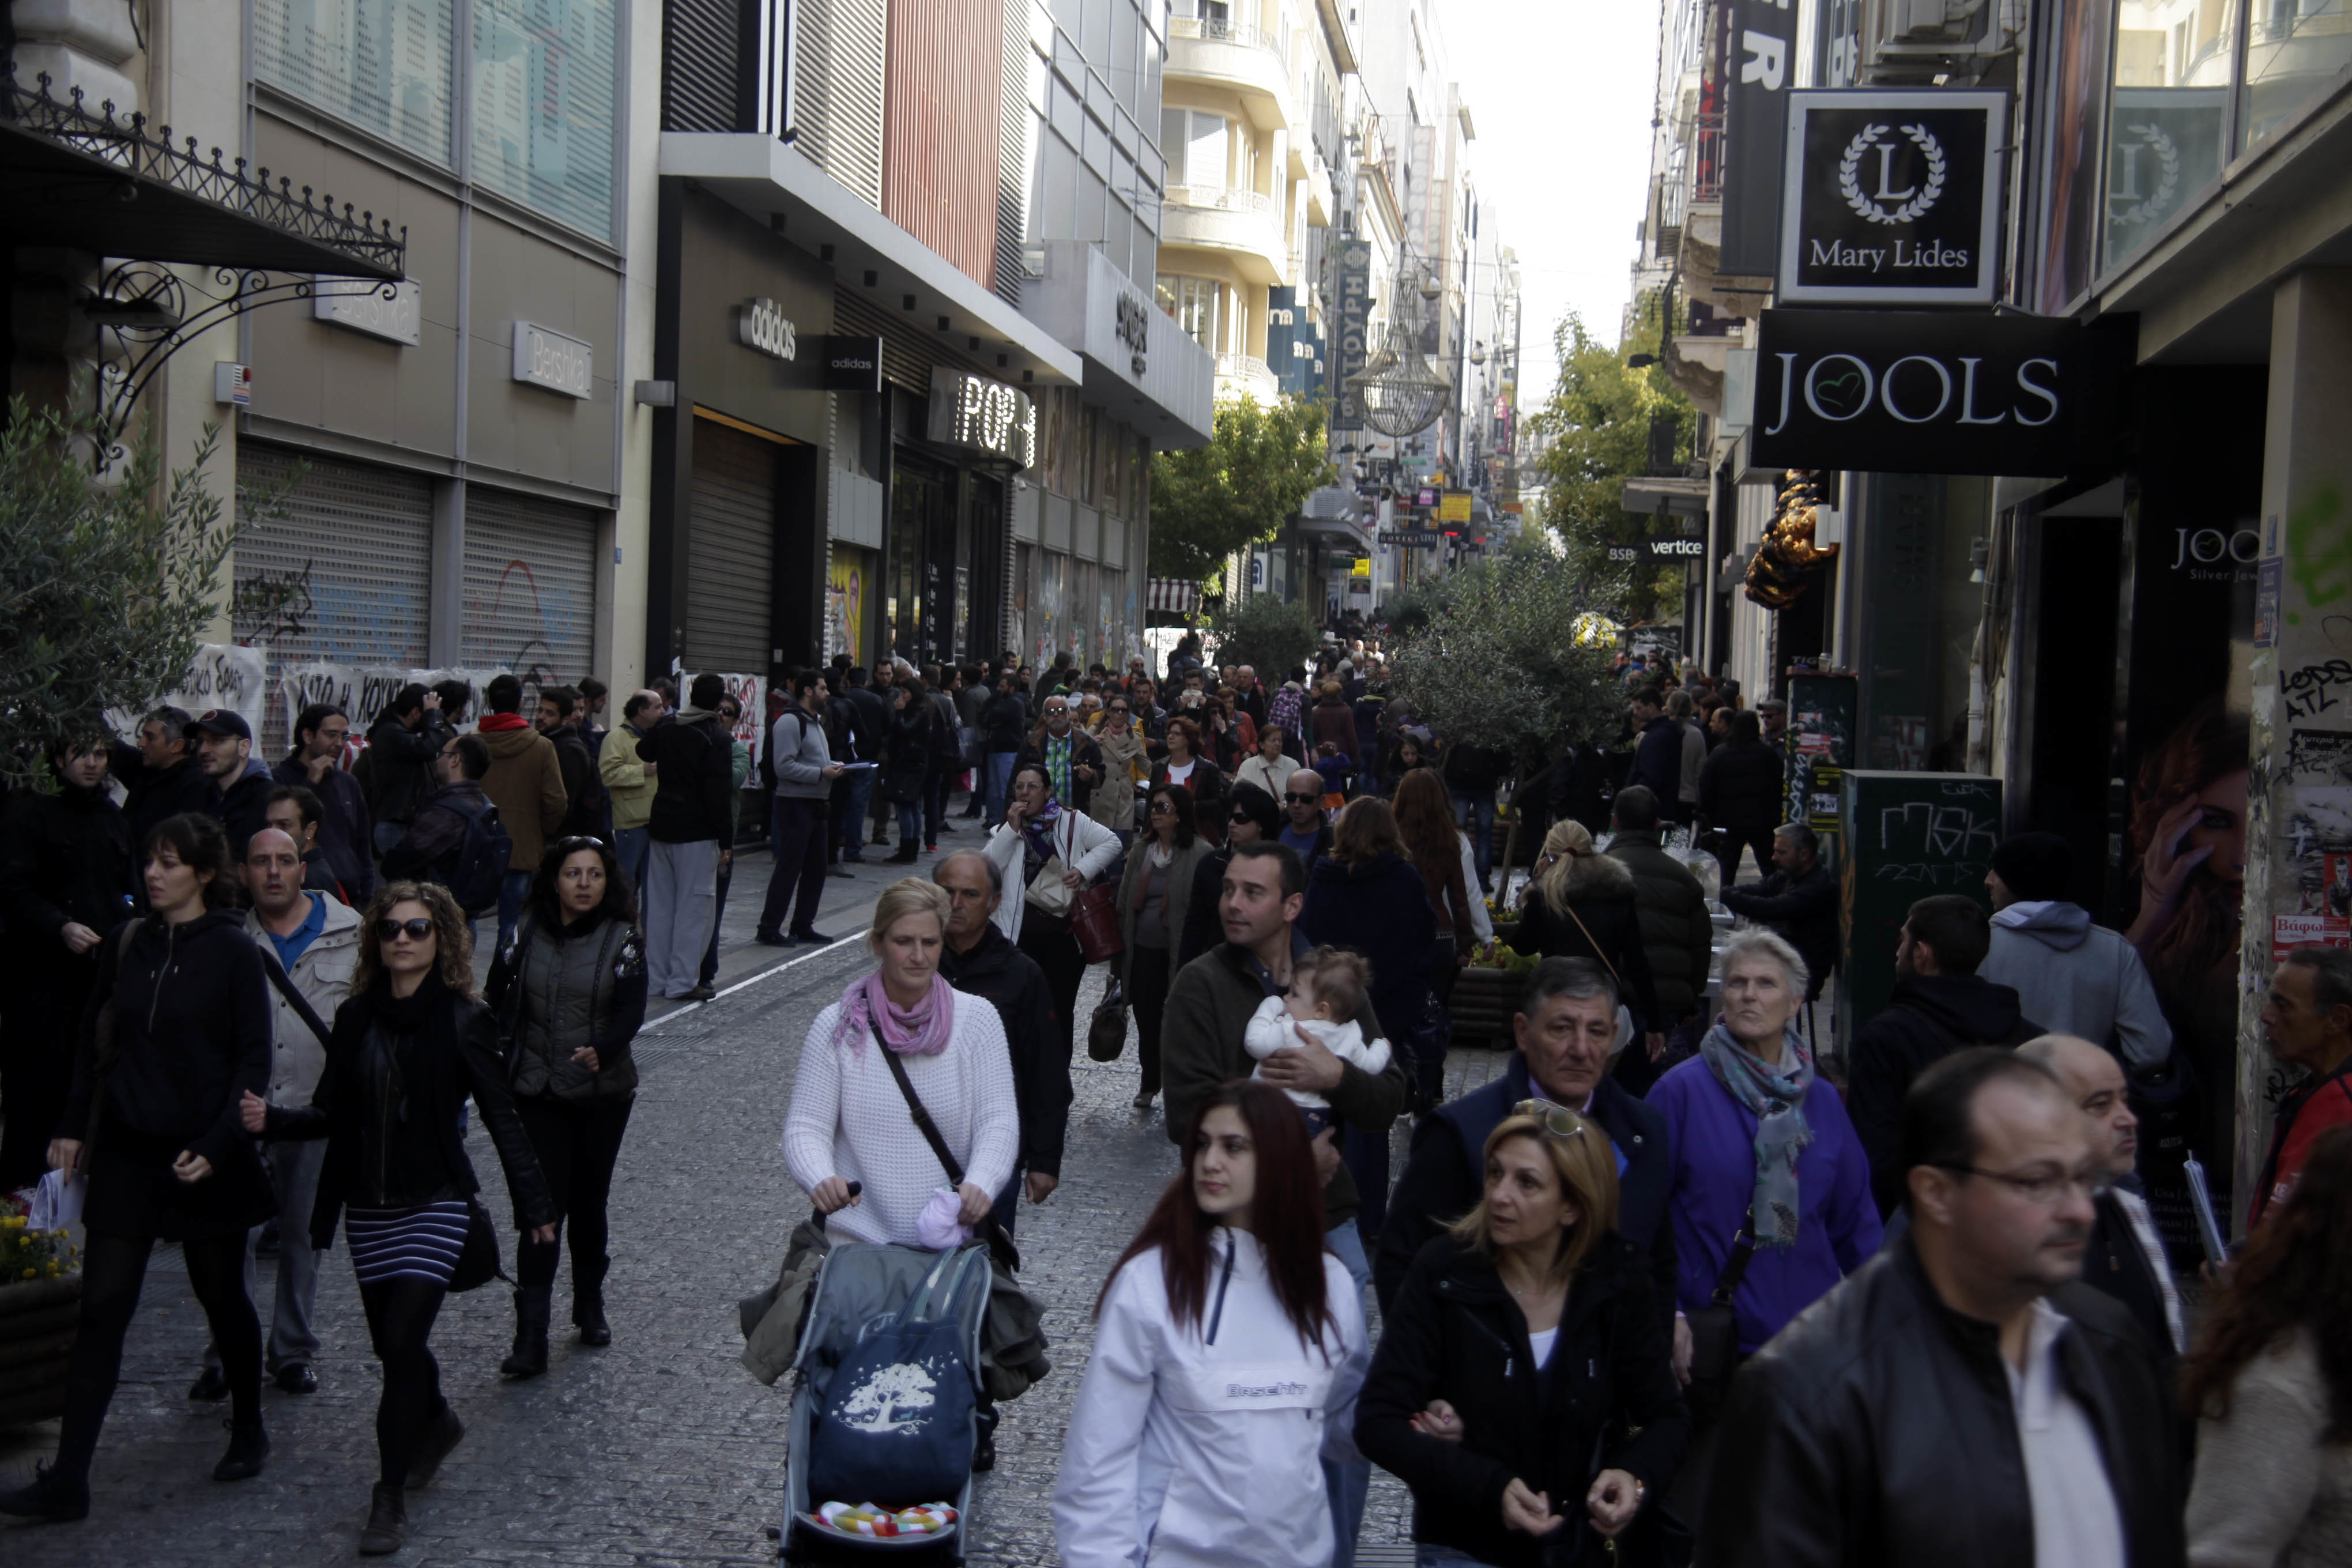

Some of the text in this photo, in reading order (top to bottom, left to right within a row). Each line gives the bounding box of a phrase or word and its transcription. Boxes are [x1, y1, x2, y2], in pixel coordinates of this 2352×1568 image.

[1875, 144, 1916, 200] L
[1810, 239, 1968, 273] Mary Lides
[751, 297, 796, 361] adidas
[533, 330, 584, 391] Bershka
[831, 357, 872, 370] adidas
[1764, 352, 2059, 436] JOOLS
[1609, 546, 1634, 561] BSB
[1650, 540, 1703, 555] vertice
[2190, 568, 2230, 581] Silver
